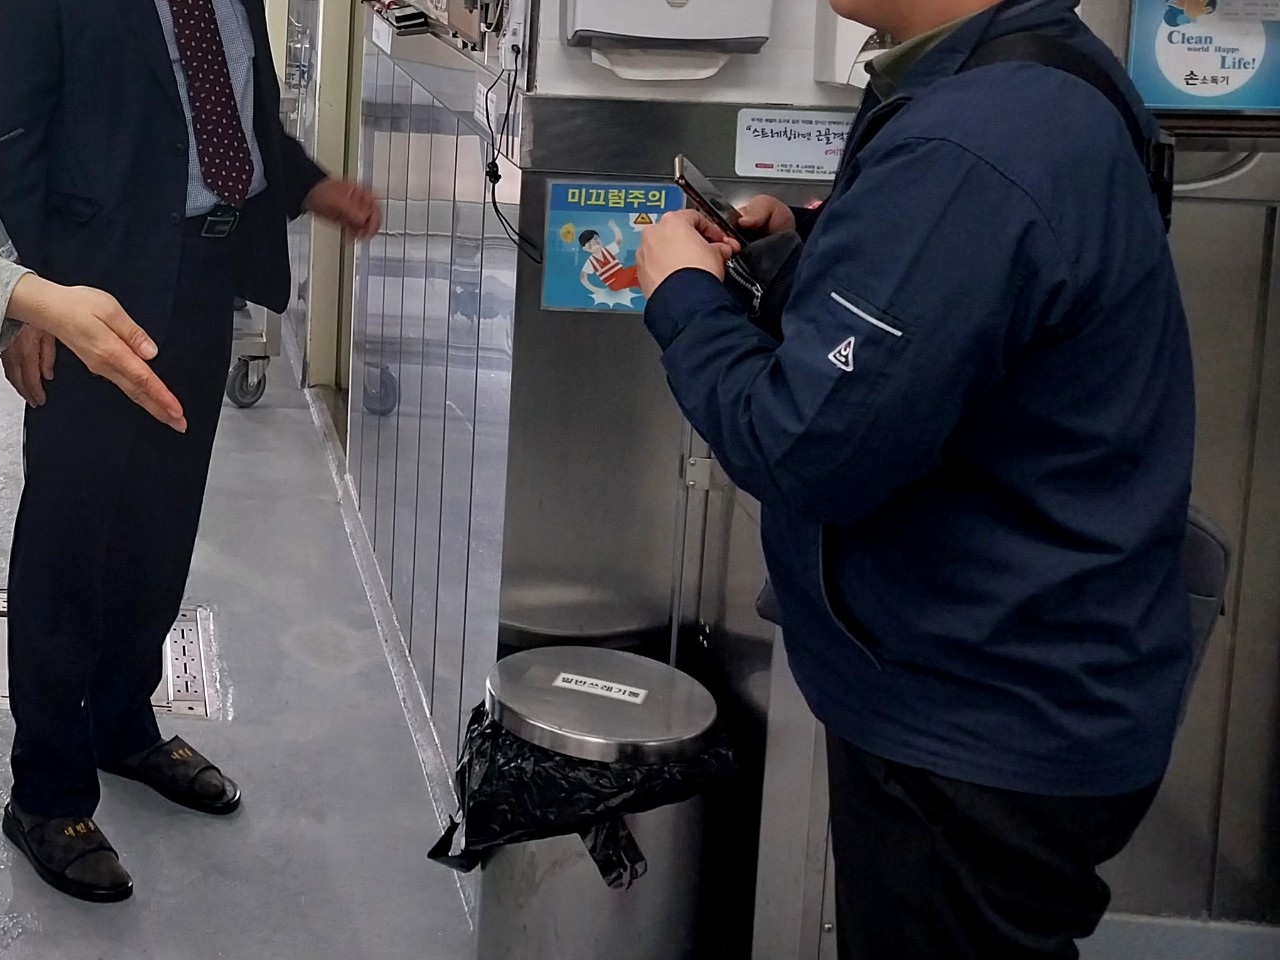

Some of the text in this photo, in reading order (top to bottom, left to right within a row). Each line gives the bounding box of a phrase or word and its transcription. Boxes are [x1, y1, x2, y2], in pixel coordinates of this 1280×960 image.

[1167, 30, 1213, 45] Clean
[1214, 46, 1239, 54] Happy
[1220, 55, 1256, 70] Life!
[1183, 70, 1230, 86] 손소독기
[567, 188, 666, 209] 미끄럼주의
[561, 677, 640, 698] 일반쓰레기통
